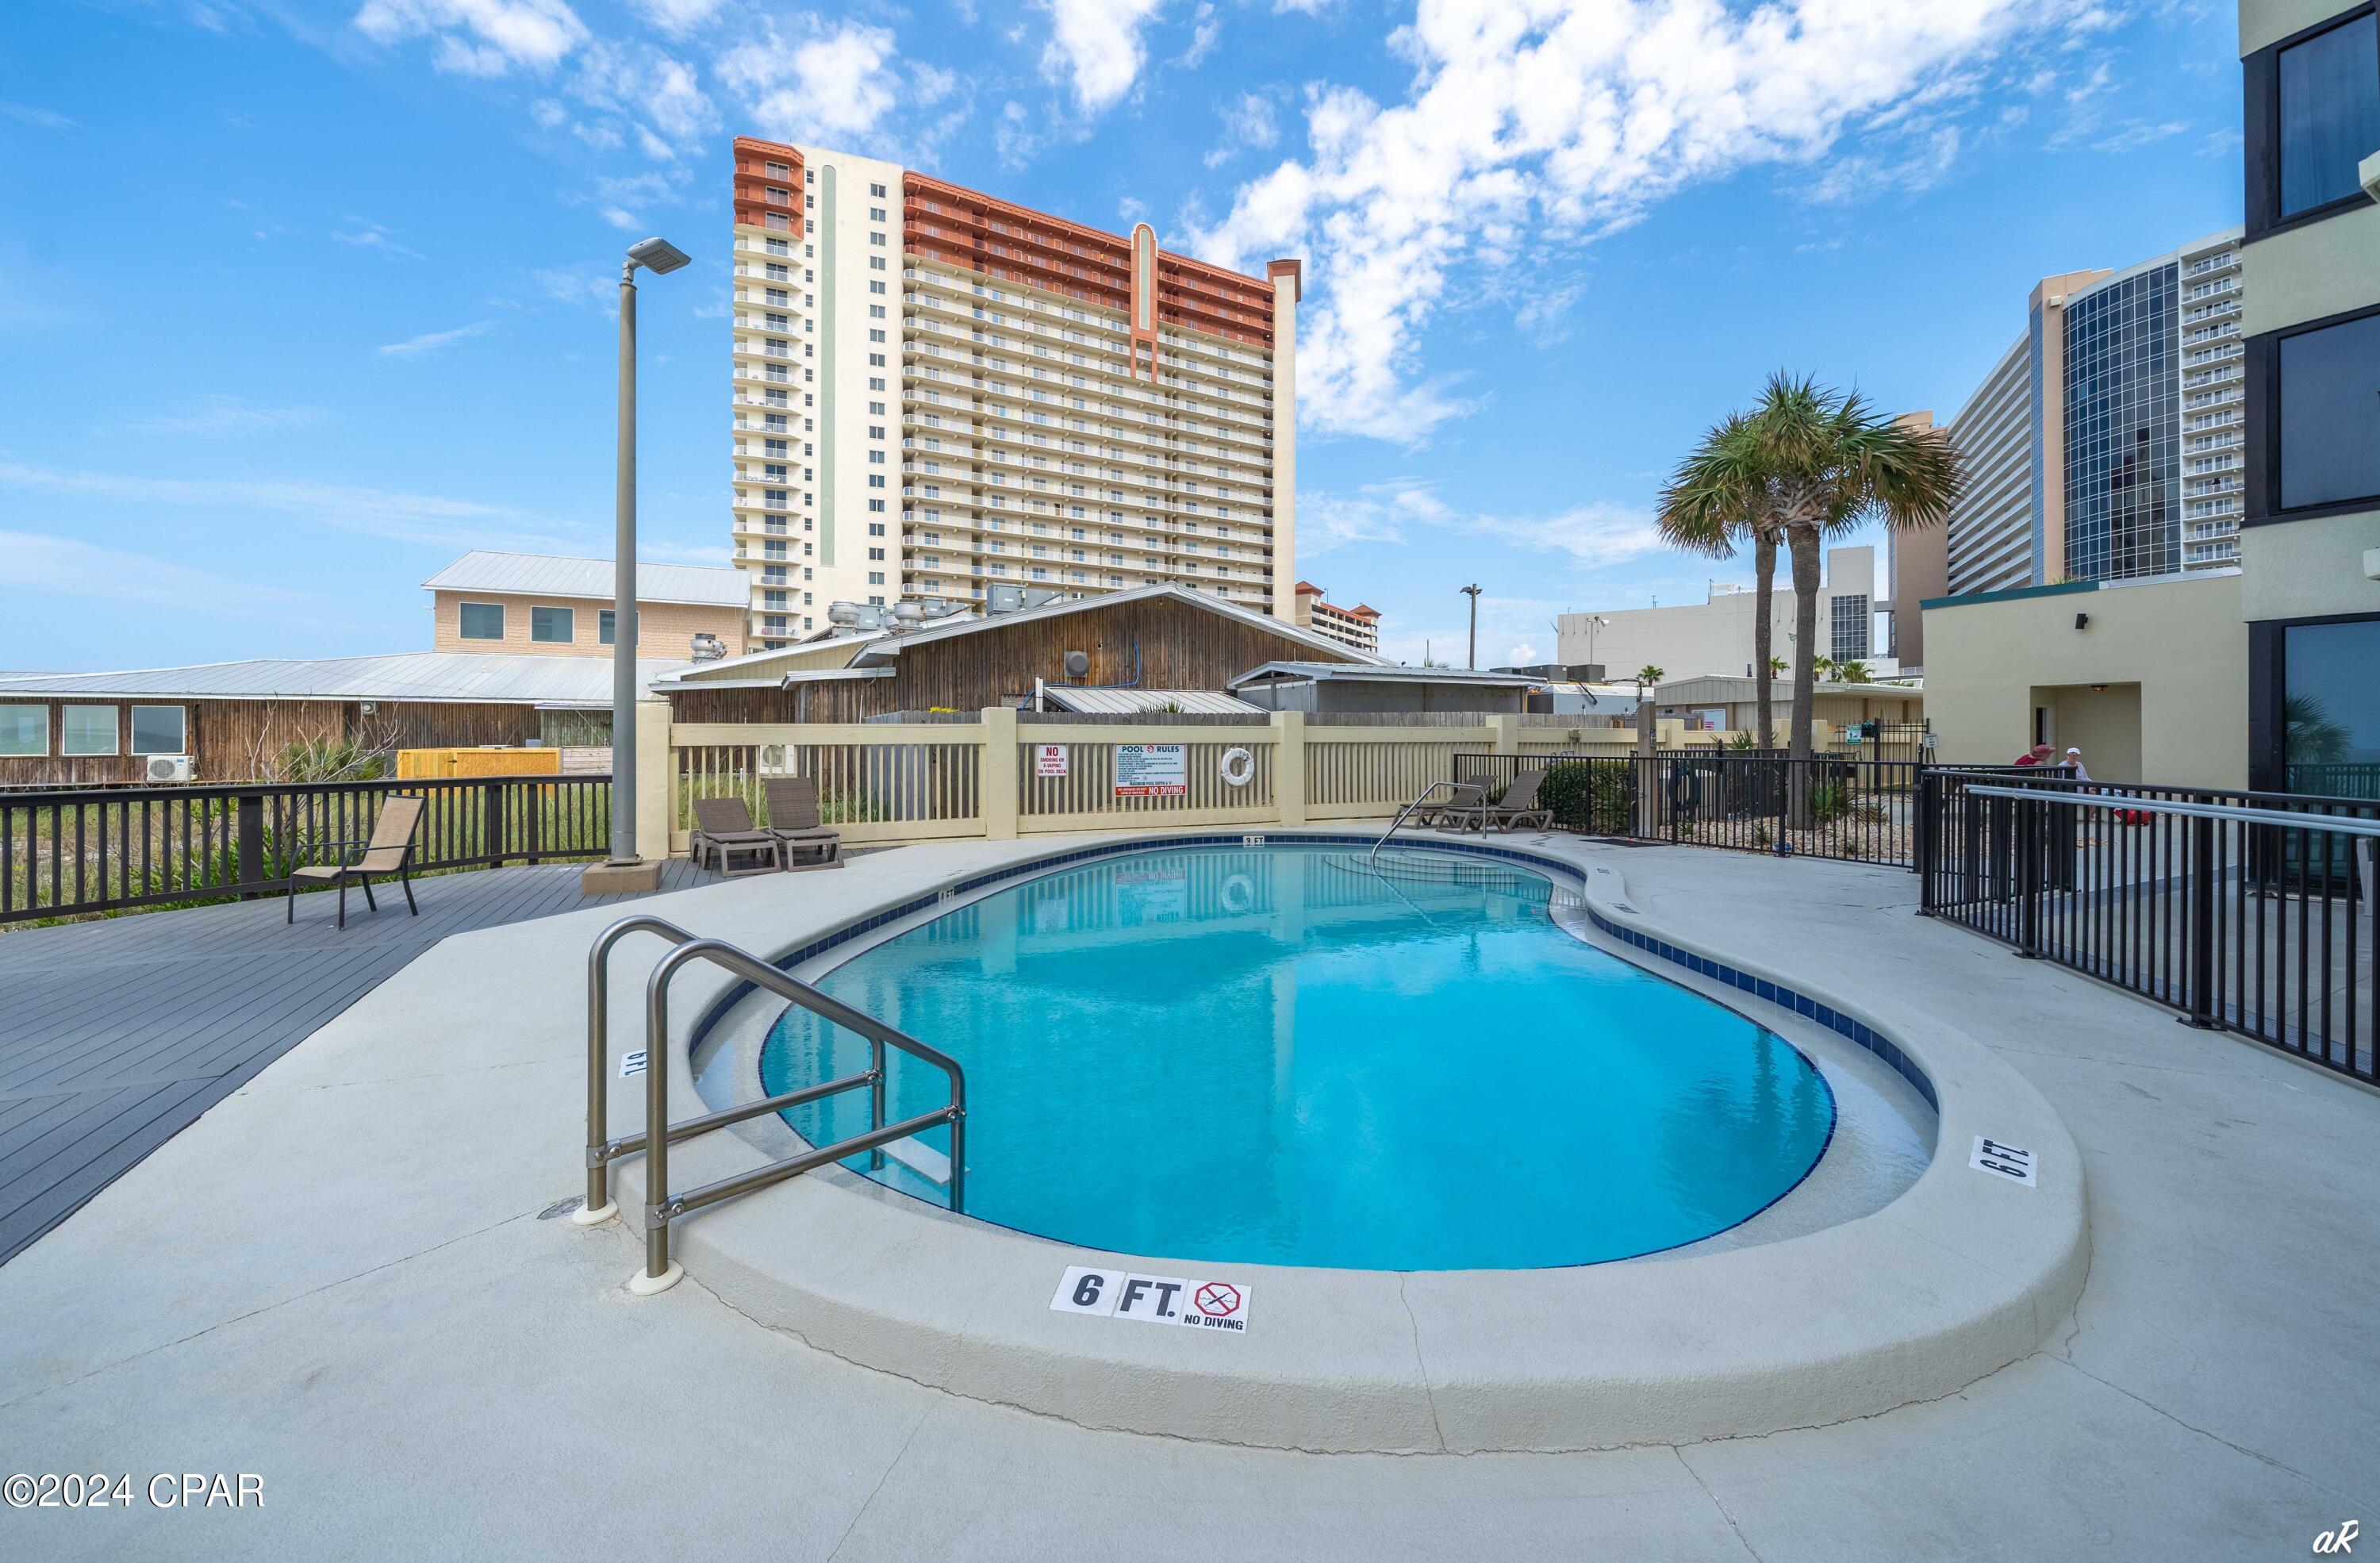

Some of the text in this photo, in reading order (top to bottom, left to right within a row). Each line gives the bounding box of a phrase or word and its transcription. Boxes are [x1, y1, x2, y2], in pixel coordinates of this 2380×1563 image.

[1046, 747, 1058, 756] NO
[1980, 1160, 2027, 1177] 6
[1073, 1274, 1182, 1317] 6 FT.
[1184, 1314, 1244, 1330] NO DIVING
